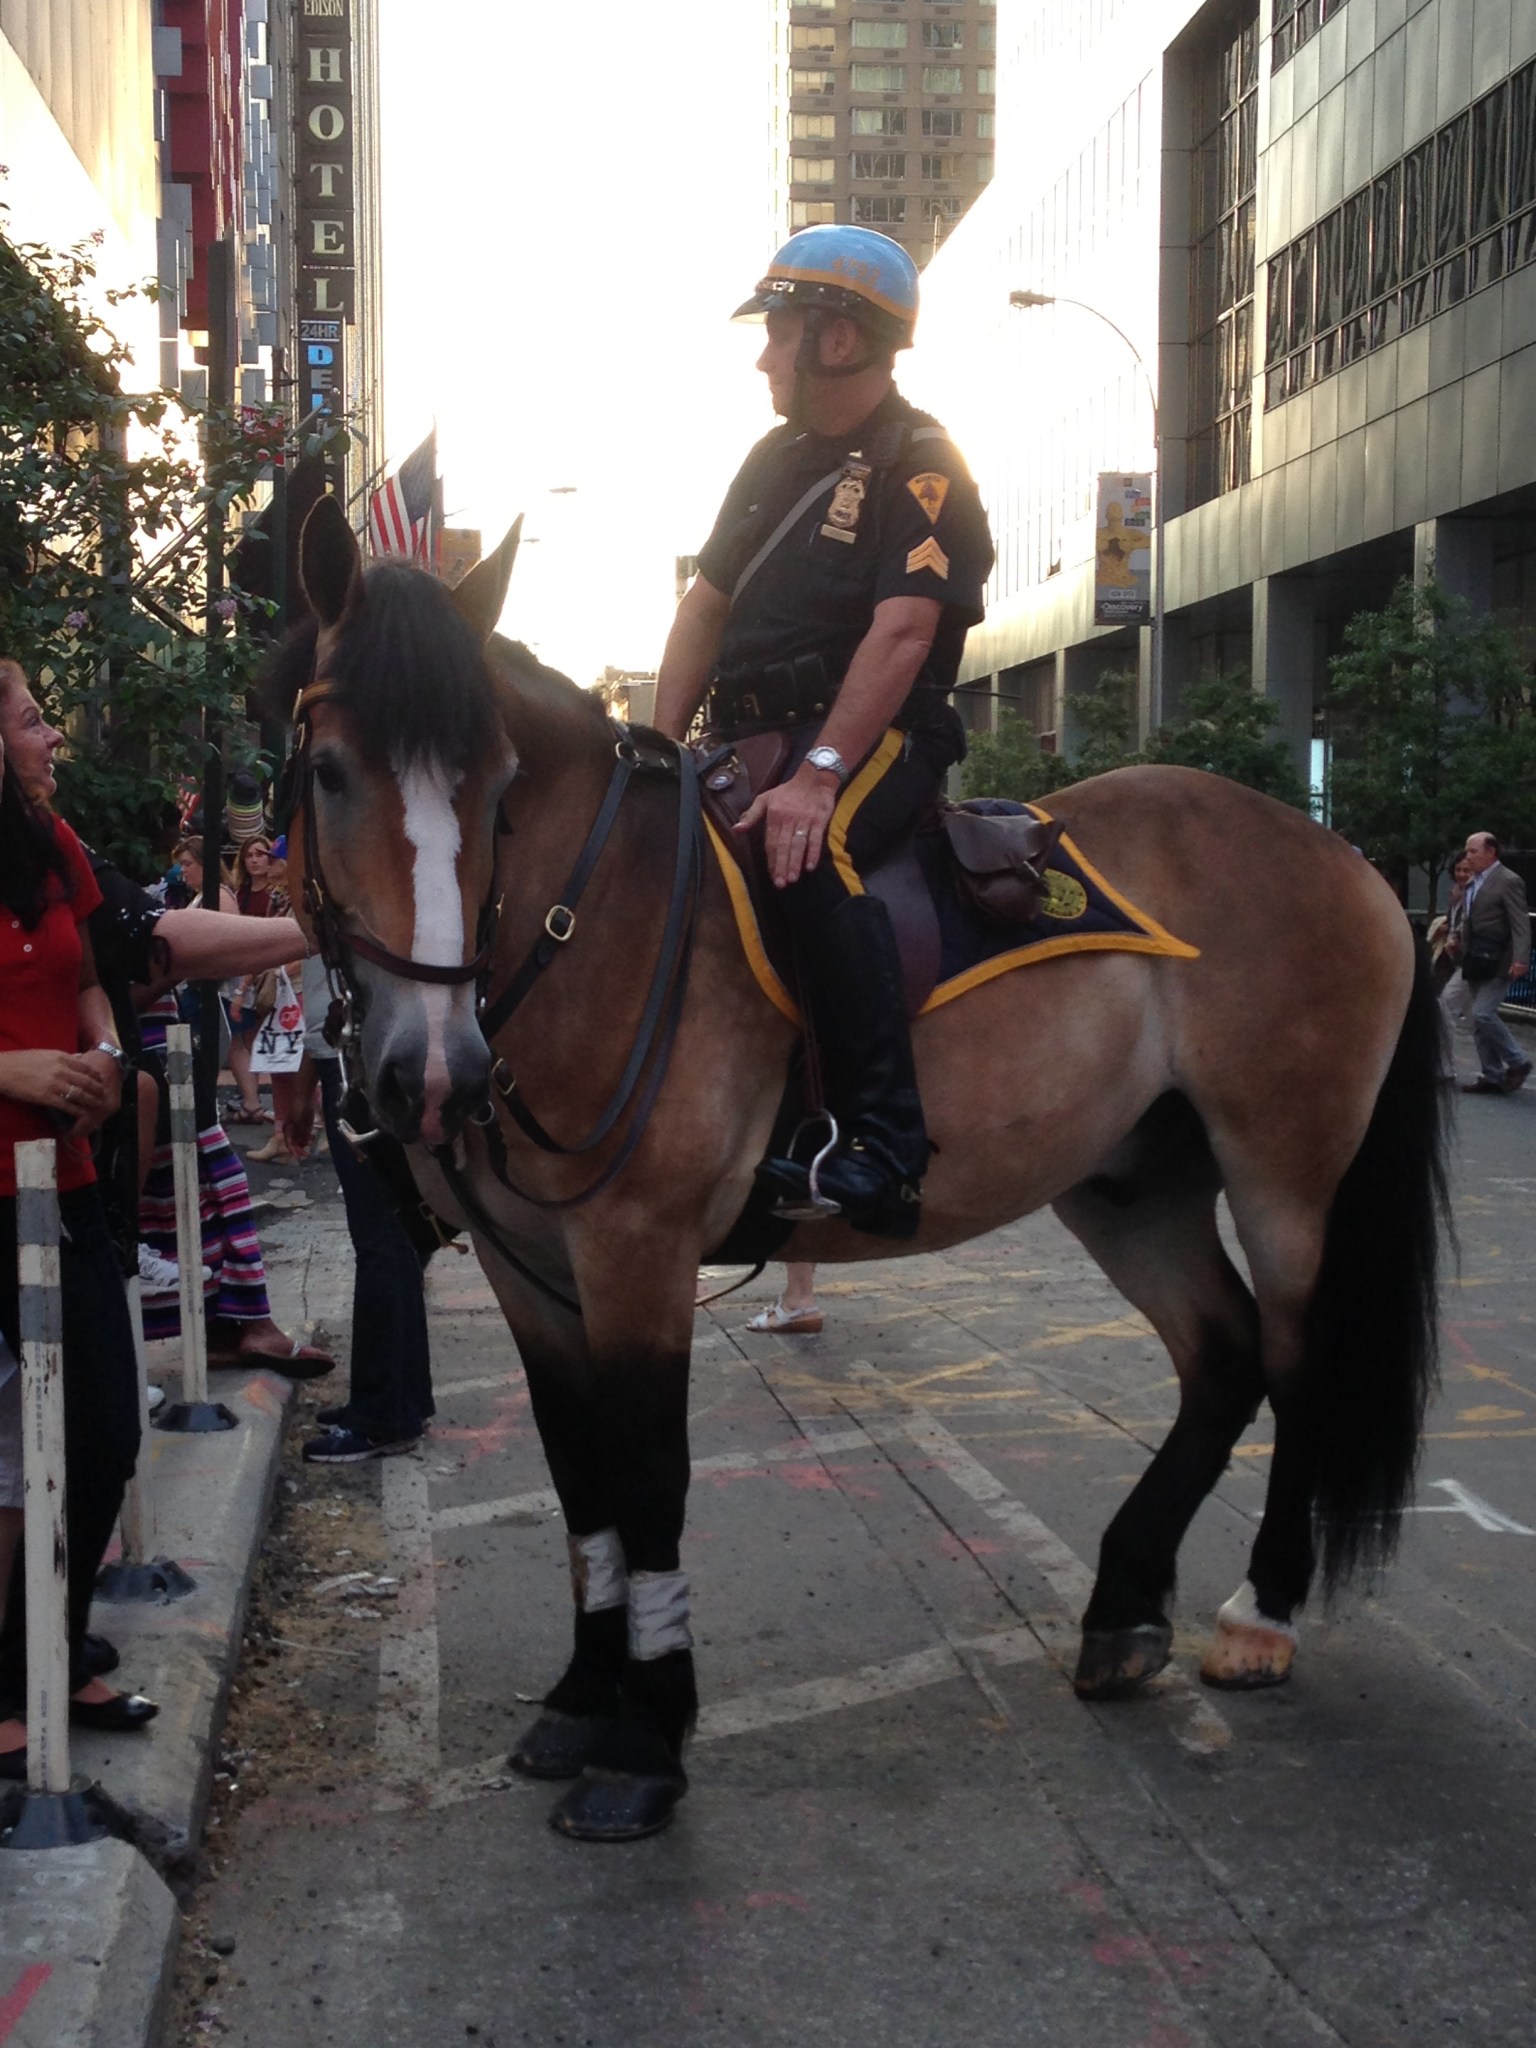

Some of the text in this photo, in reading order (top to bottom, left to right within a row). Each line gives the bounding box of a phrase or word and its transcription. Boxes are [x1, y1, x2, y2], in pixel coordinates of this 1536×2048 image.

[304, 0, 344, 17] EDISON
[307, 47, 345, 314] HOTEL
[301, 324, 339, 339] 24HR
[257, 1030, 303, 1054] NY
